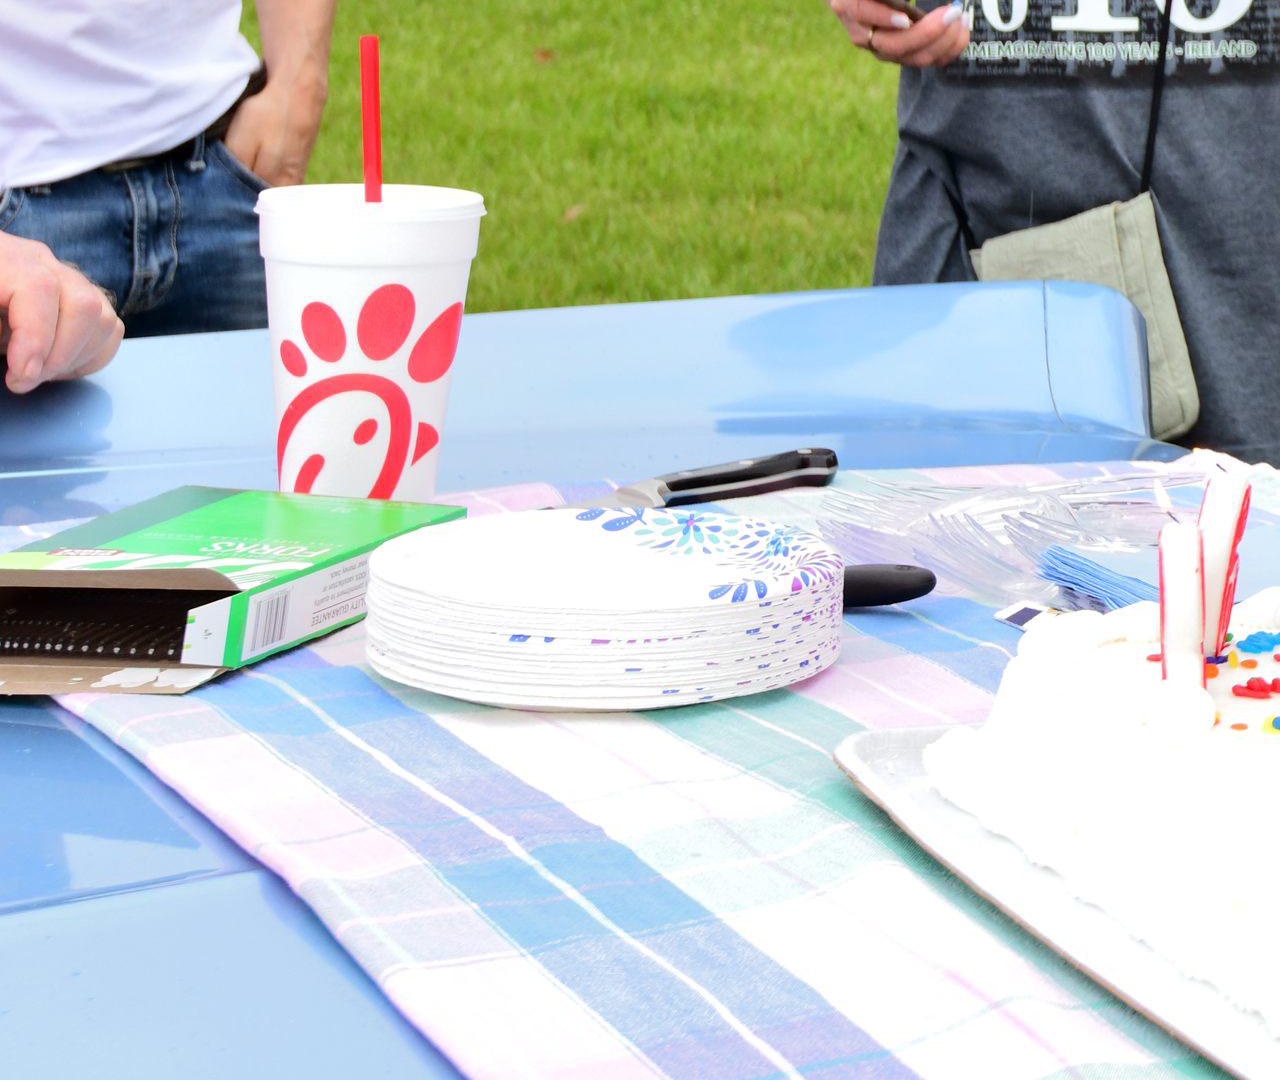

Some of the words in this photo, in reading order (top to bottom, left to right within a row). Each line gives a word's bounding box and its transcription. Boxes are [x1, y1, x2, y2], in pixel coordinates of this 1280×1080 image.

[1086, 41, 1116, 61] 100
[1185, 38, 1257, 59] IRELAND
[201, 542, 332, 558] FORKS
[311, 604, 350, 626] GUARANTEE
